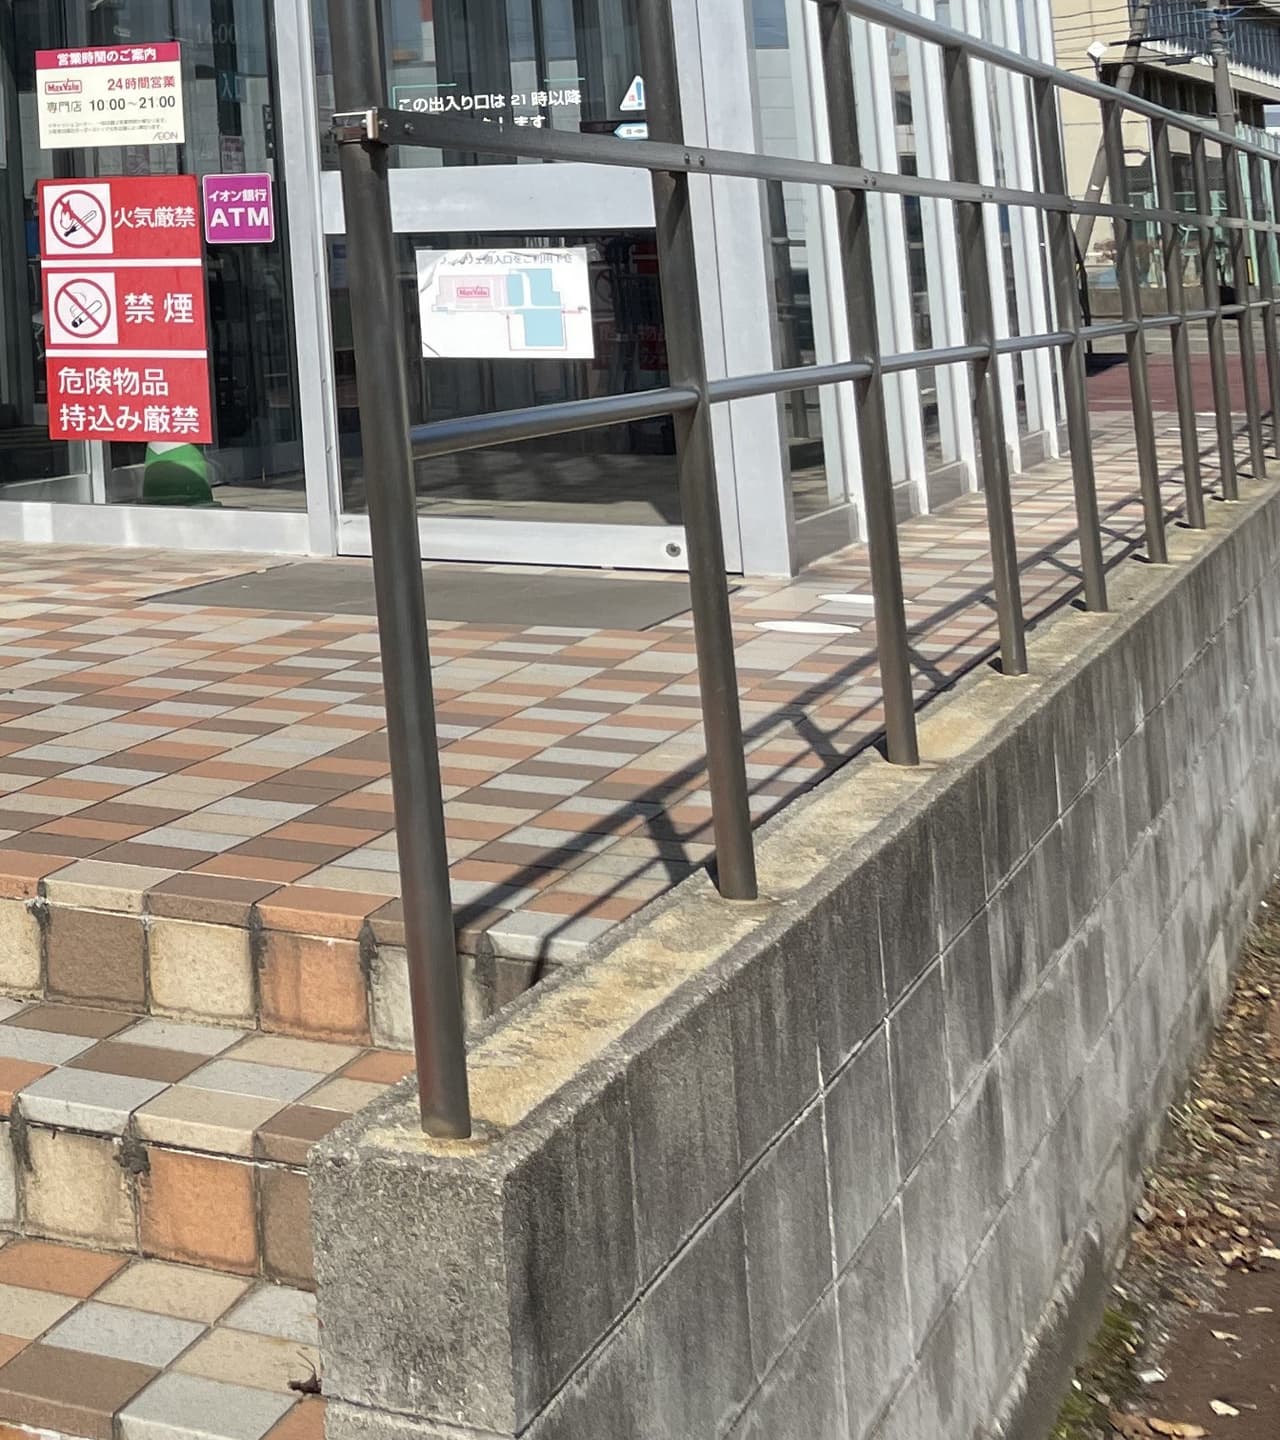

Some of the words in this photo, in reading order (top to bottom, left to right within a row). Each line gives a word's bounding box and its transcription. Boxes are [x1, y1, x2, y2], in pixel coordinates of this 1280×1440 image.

[57, 47, 156, 66] 営業時間のご案内
[46, 100, 82, 114] 専門店
[208, 188, 267, 203] イオン銀行
[113, 205, 196, 230] 火気厳禁
[210, 207, 270, 229] ATM
[124, 292, 195, 325] 禁煙
[57, 366, 169, 397] 危険物品
[58, 402, 200, 435] 持込み厳禁
